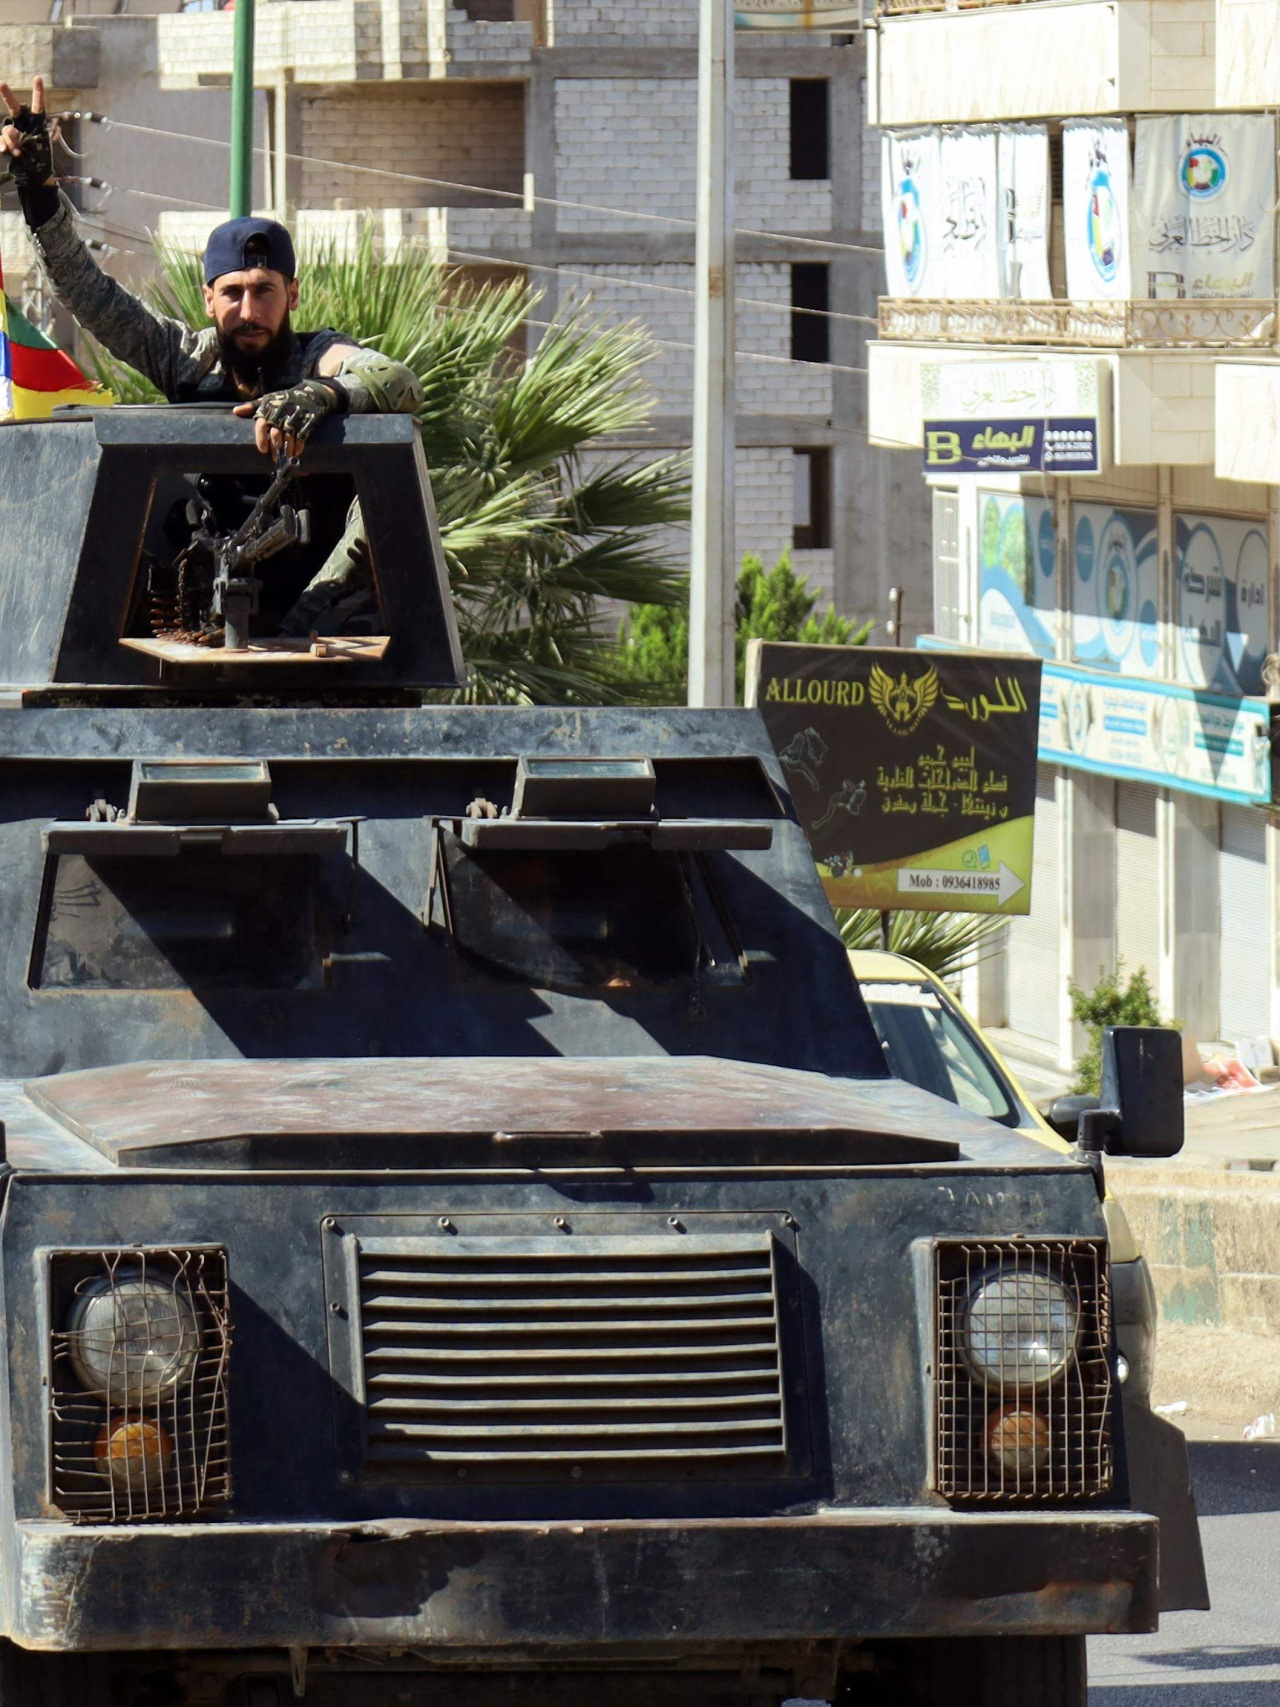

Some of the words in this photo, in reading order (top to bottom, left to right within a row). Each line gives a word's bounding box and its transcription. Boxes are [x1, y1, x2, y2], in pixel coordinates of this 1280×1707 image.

[926, 431, 962, 465] B
[972, 425, 1035, 453] البهاء
[765, 676, 865, 706] ALLOURD
[940, 675, 1028, 721] اللورد
[909, 874, 933, 888] Mob
[942, 875, 1000, 890] 0936418985
